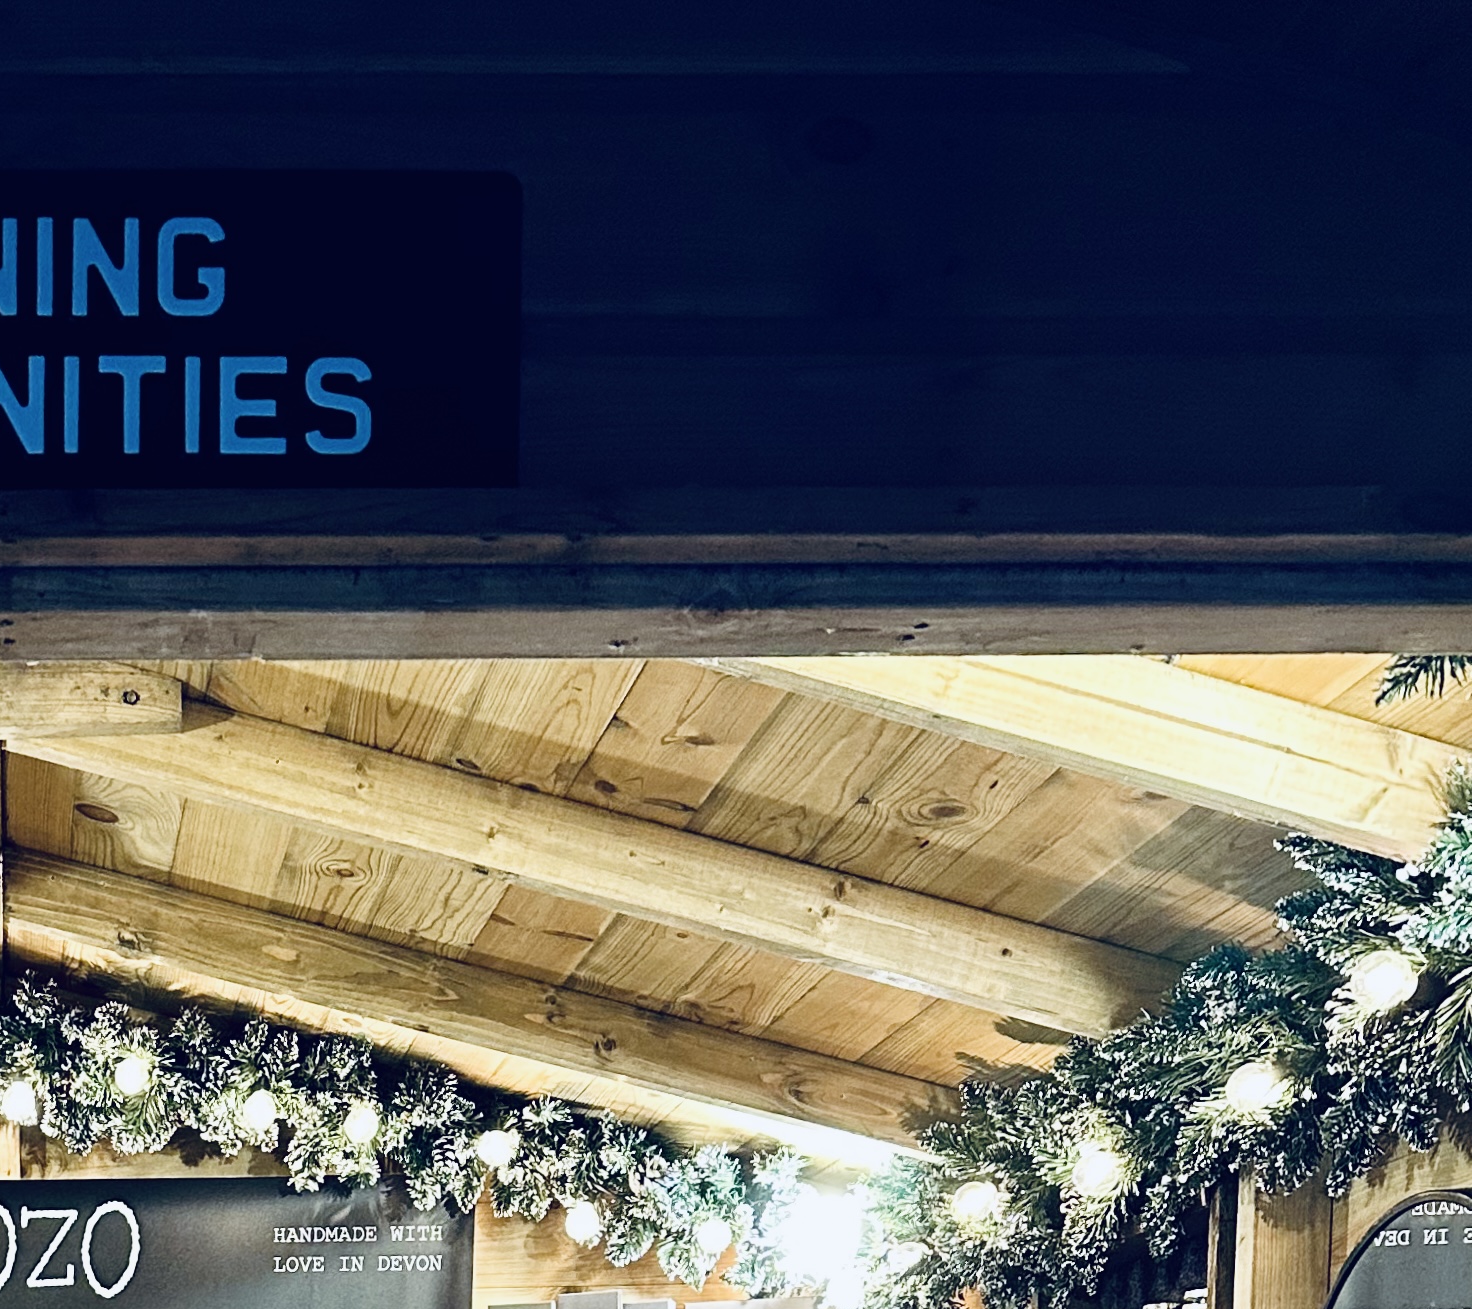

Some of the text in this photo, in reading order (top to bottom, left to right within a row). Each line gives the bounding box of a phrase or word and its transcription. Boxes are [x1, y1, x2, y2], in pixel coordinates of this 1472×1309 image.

[273, 1224, 444, 1244] HANDMADE WITH
[273, 1254, 443, 1274] LOVE IN DEVON
